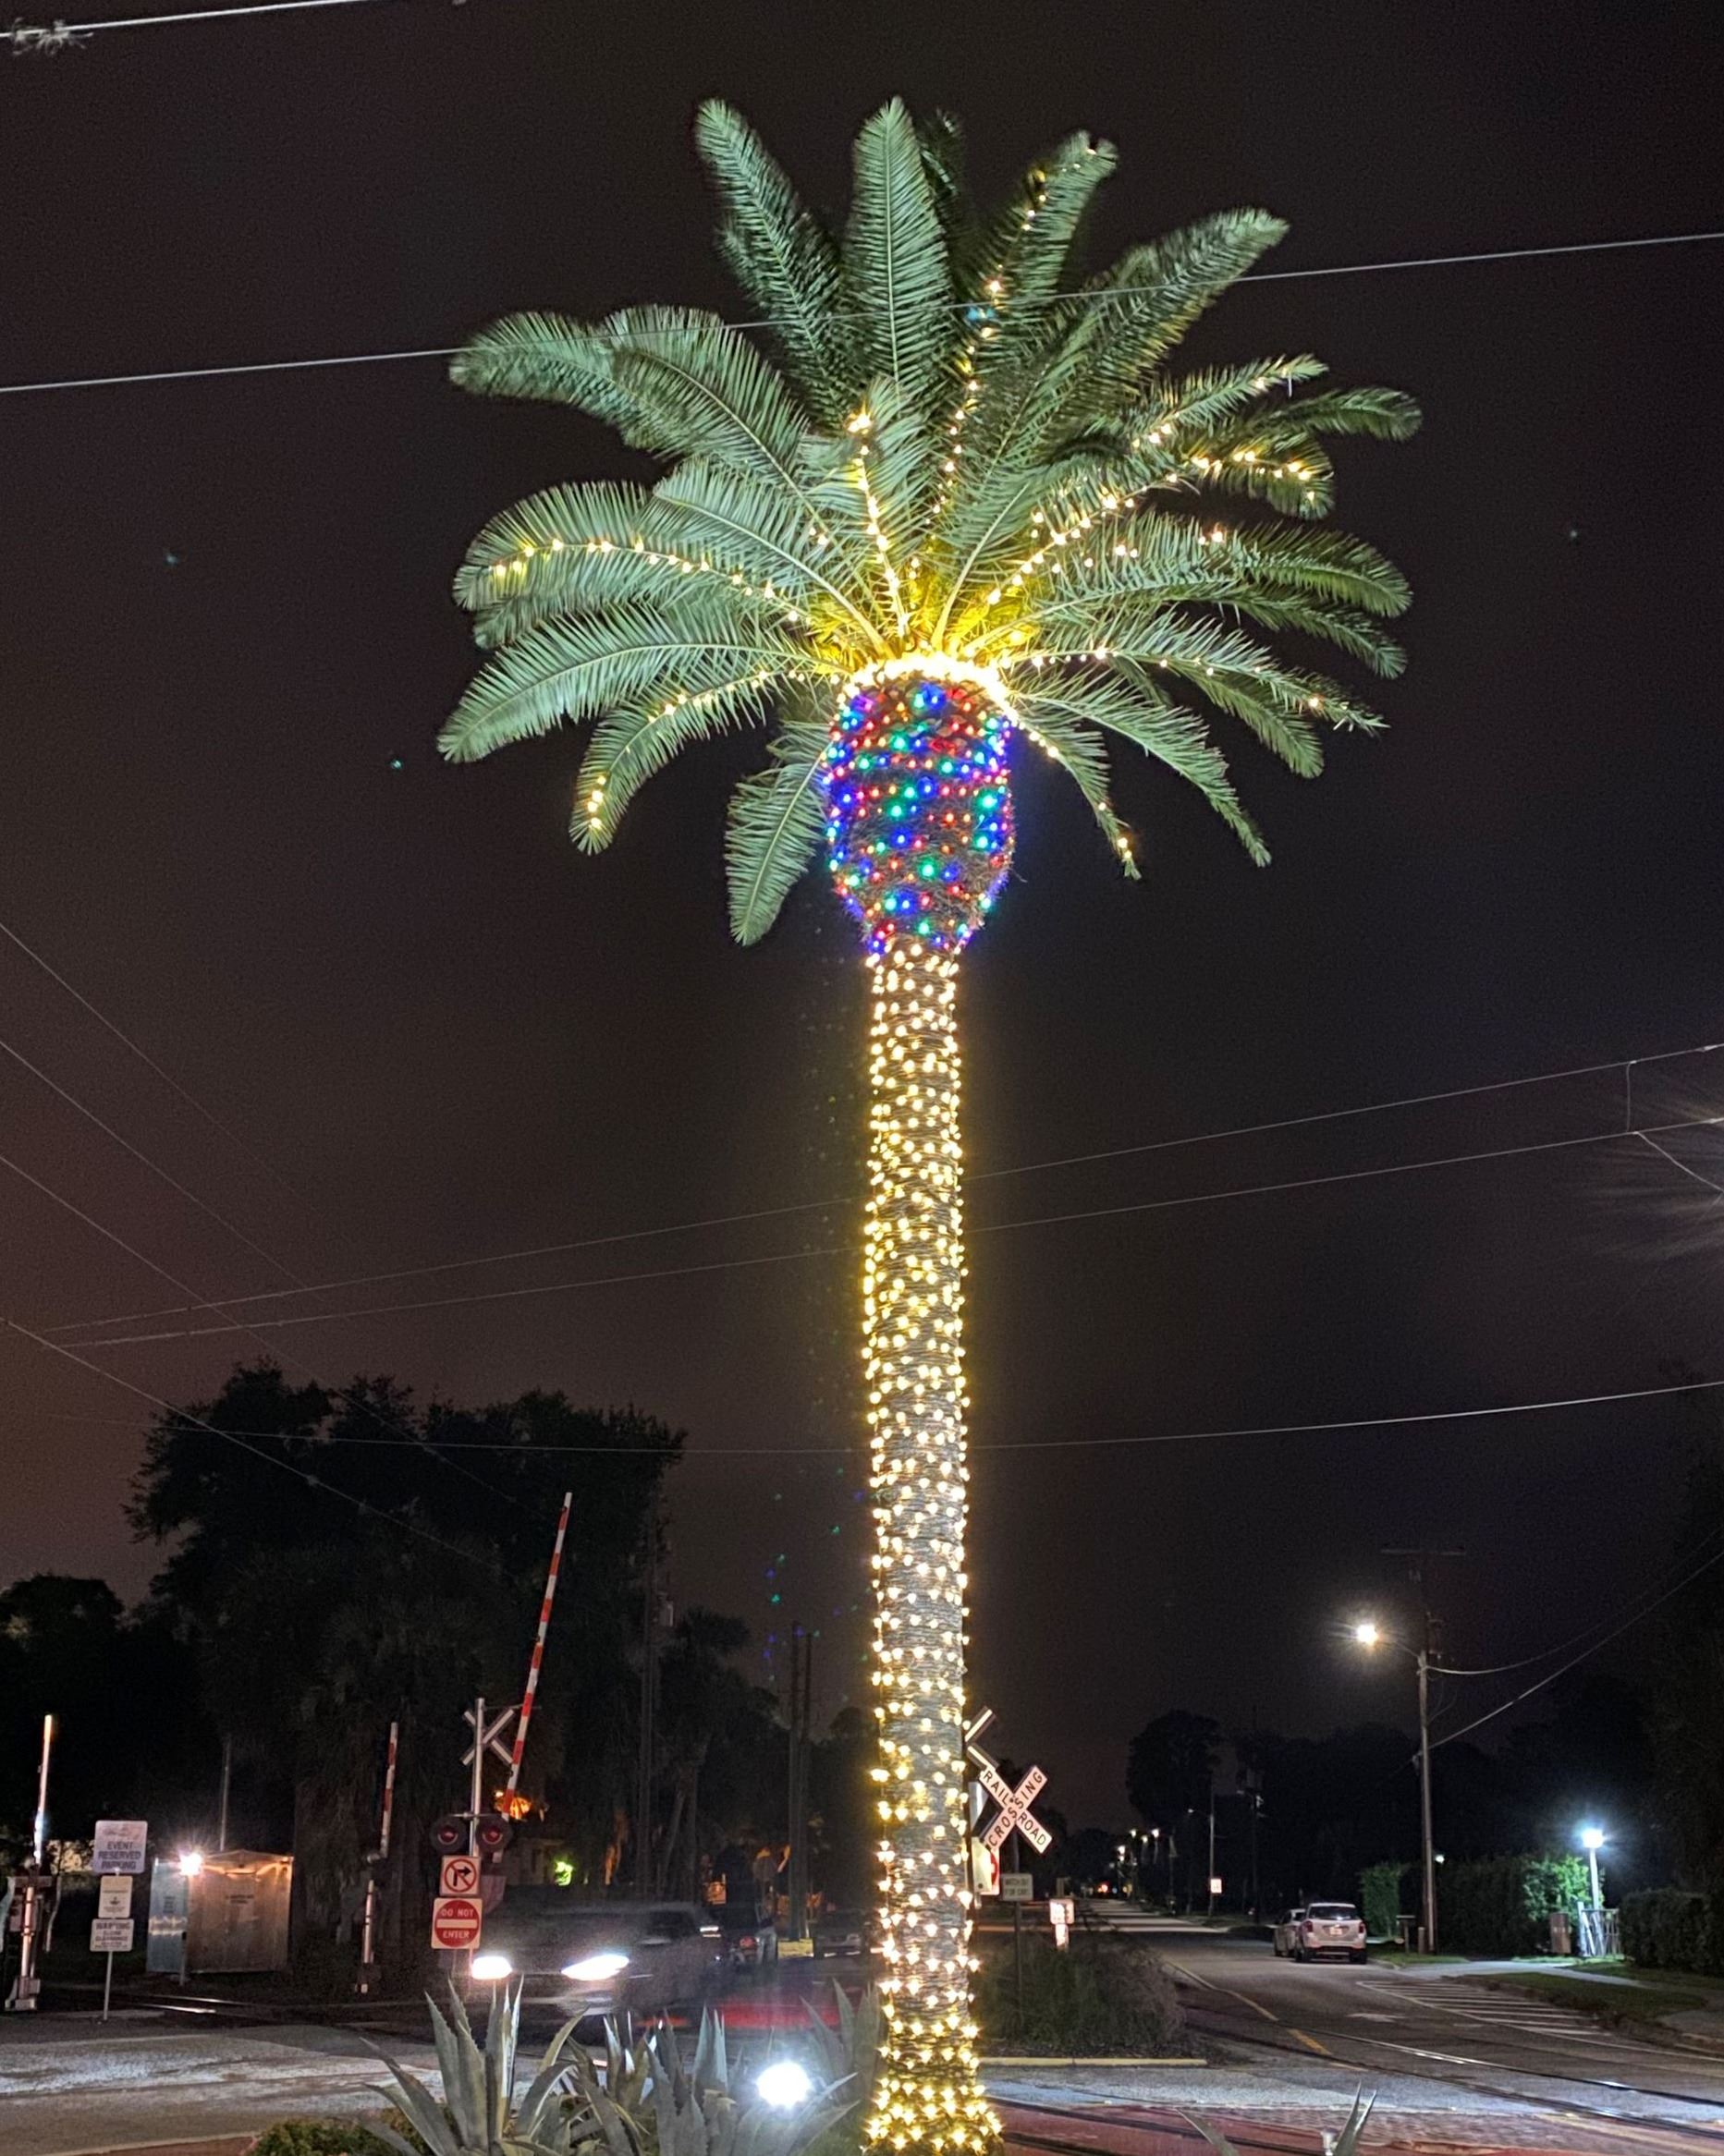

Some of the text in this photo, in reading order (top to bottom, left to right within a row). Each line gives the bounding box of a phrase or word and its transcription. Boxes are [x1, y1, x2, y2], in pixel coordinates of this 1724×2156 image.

[984, 1771, 1009, 1806] RAIL
[988, 1772, 1043, 1846] CROSSING
[1018, 1811, 1046, 1845] ROAD
[107, 1841, 133, 1849] EVENT
[98, 1850, 141, 1859] RESERVED
[102, 1860, 136, 1870] PARKING
[441, 1908, 474, 1918] DO NOT
[443, 1930, 470, 1939] ENTER
